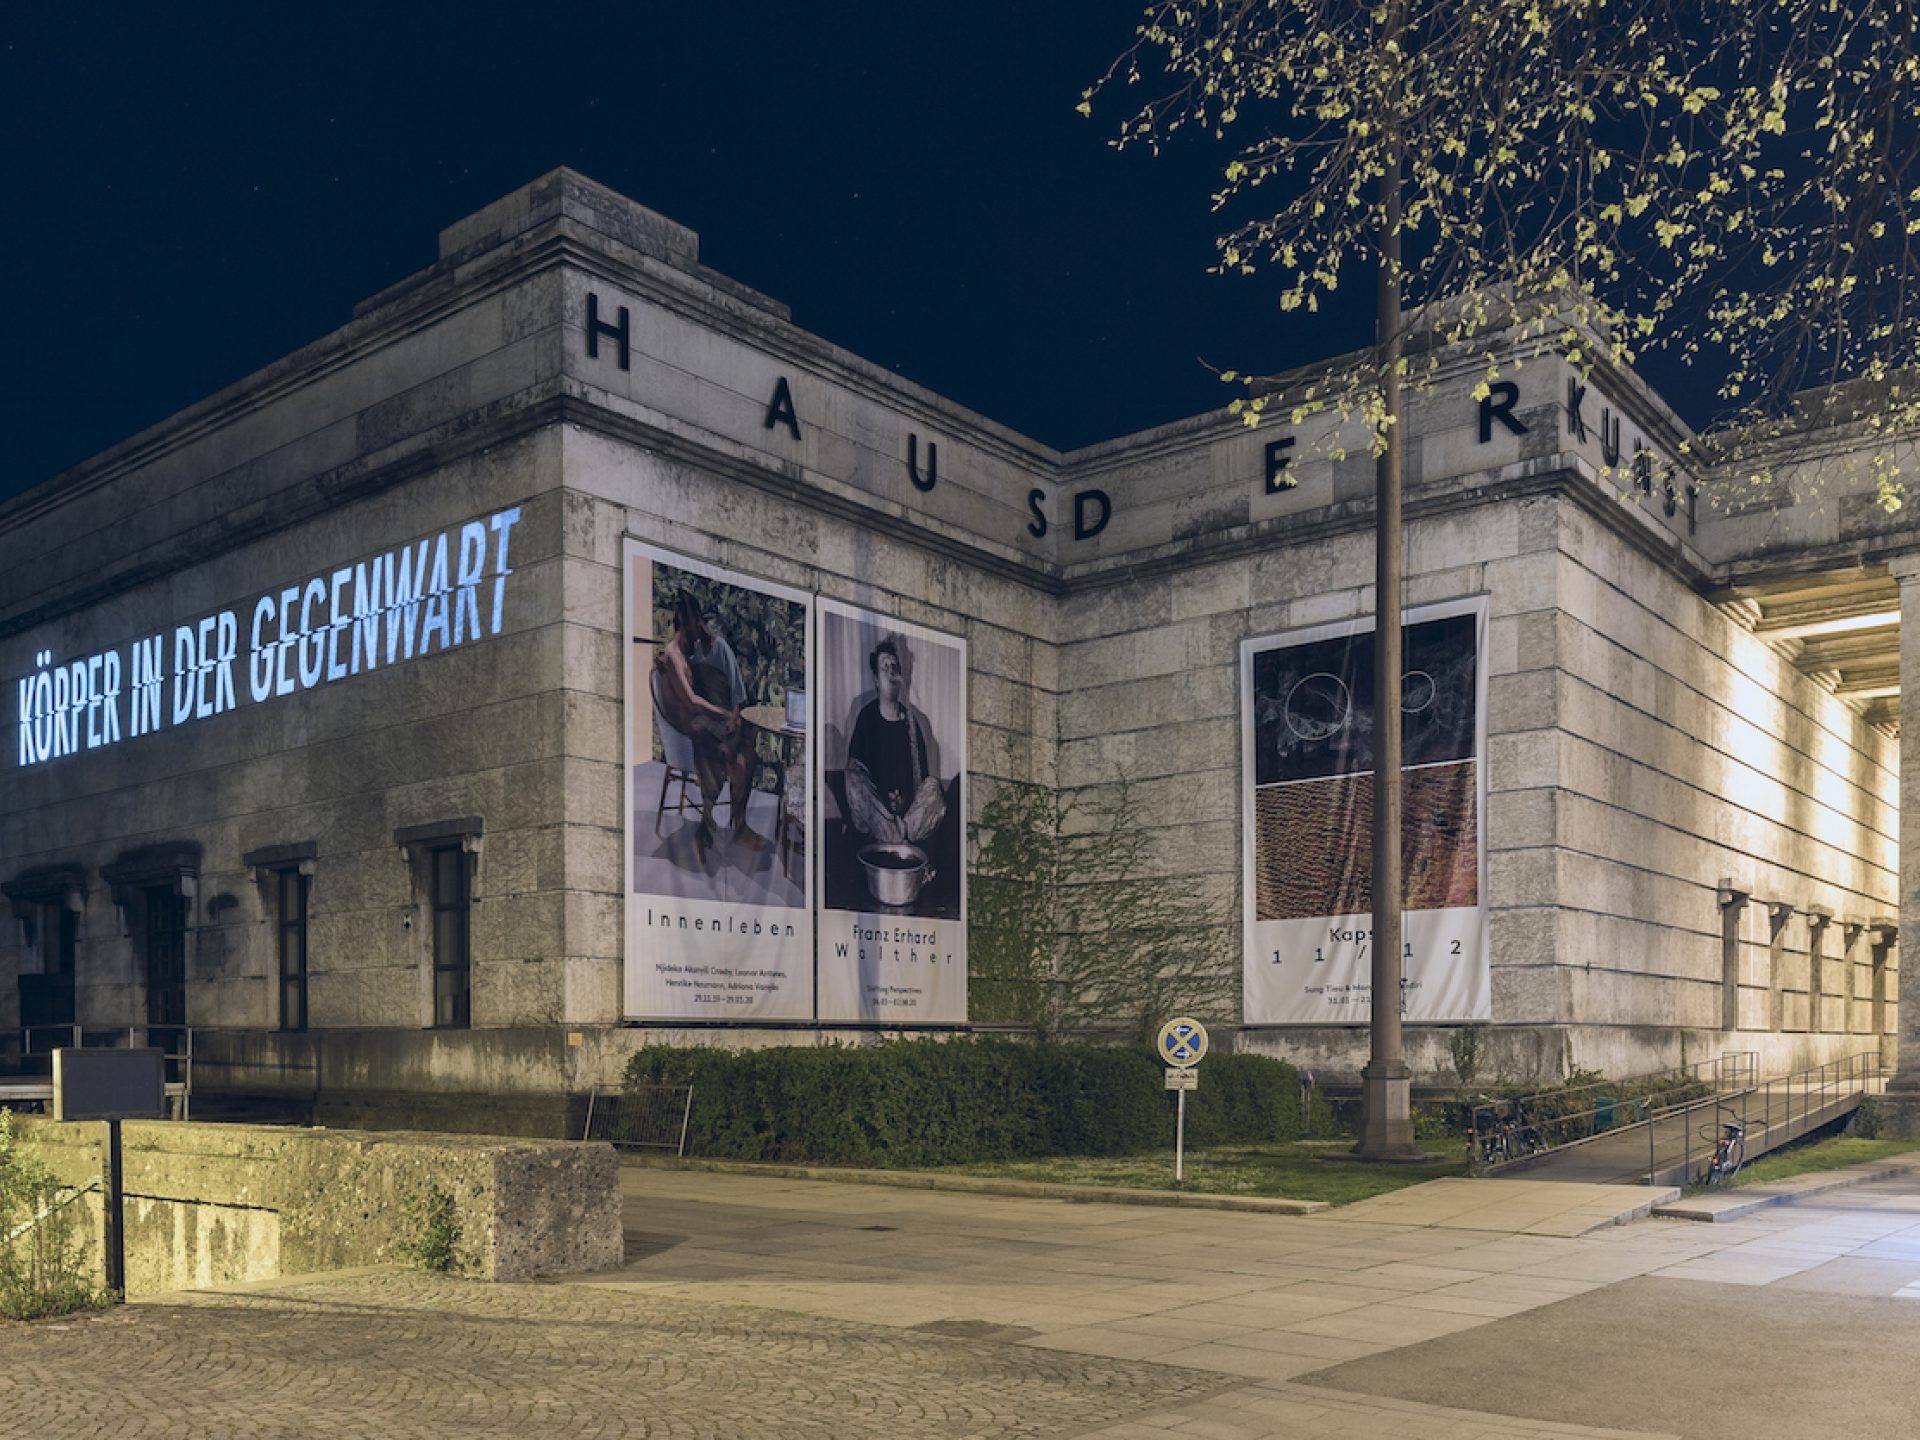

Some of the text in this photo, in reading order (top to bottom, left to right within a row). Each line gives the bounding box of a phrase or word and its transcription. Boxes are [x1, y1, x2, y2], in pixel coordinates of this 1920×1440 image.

[586, 292, 1047, 538] HAUS
[1074, 379, 1529, 542] DER
[18, 506, 522, 767] KÖRPER IN DER GEGENWART
[647, 908, 795, 937] Innenleben
[853, 924, 936, 945] Franz Erhard
[1329, 928, 1373, 945] Kap
[835, 942, 952, 964] Walther
